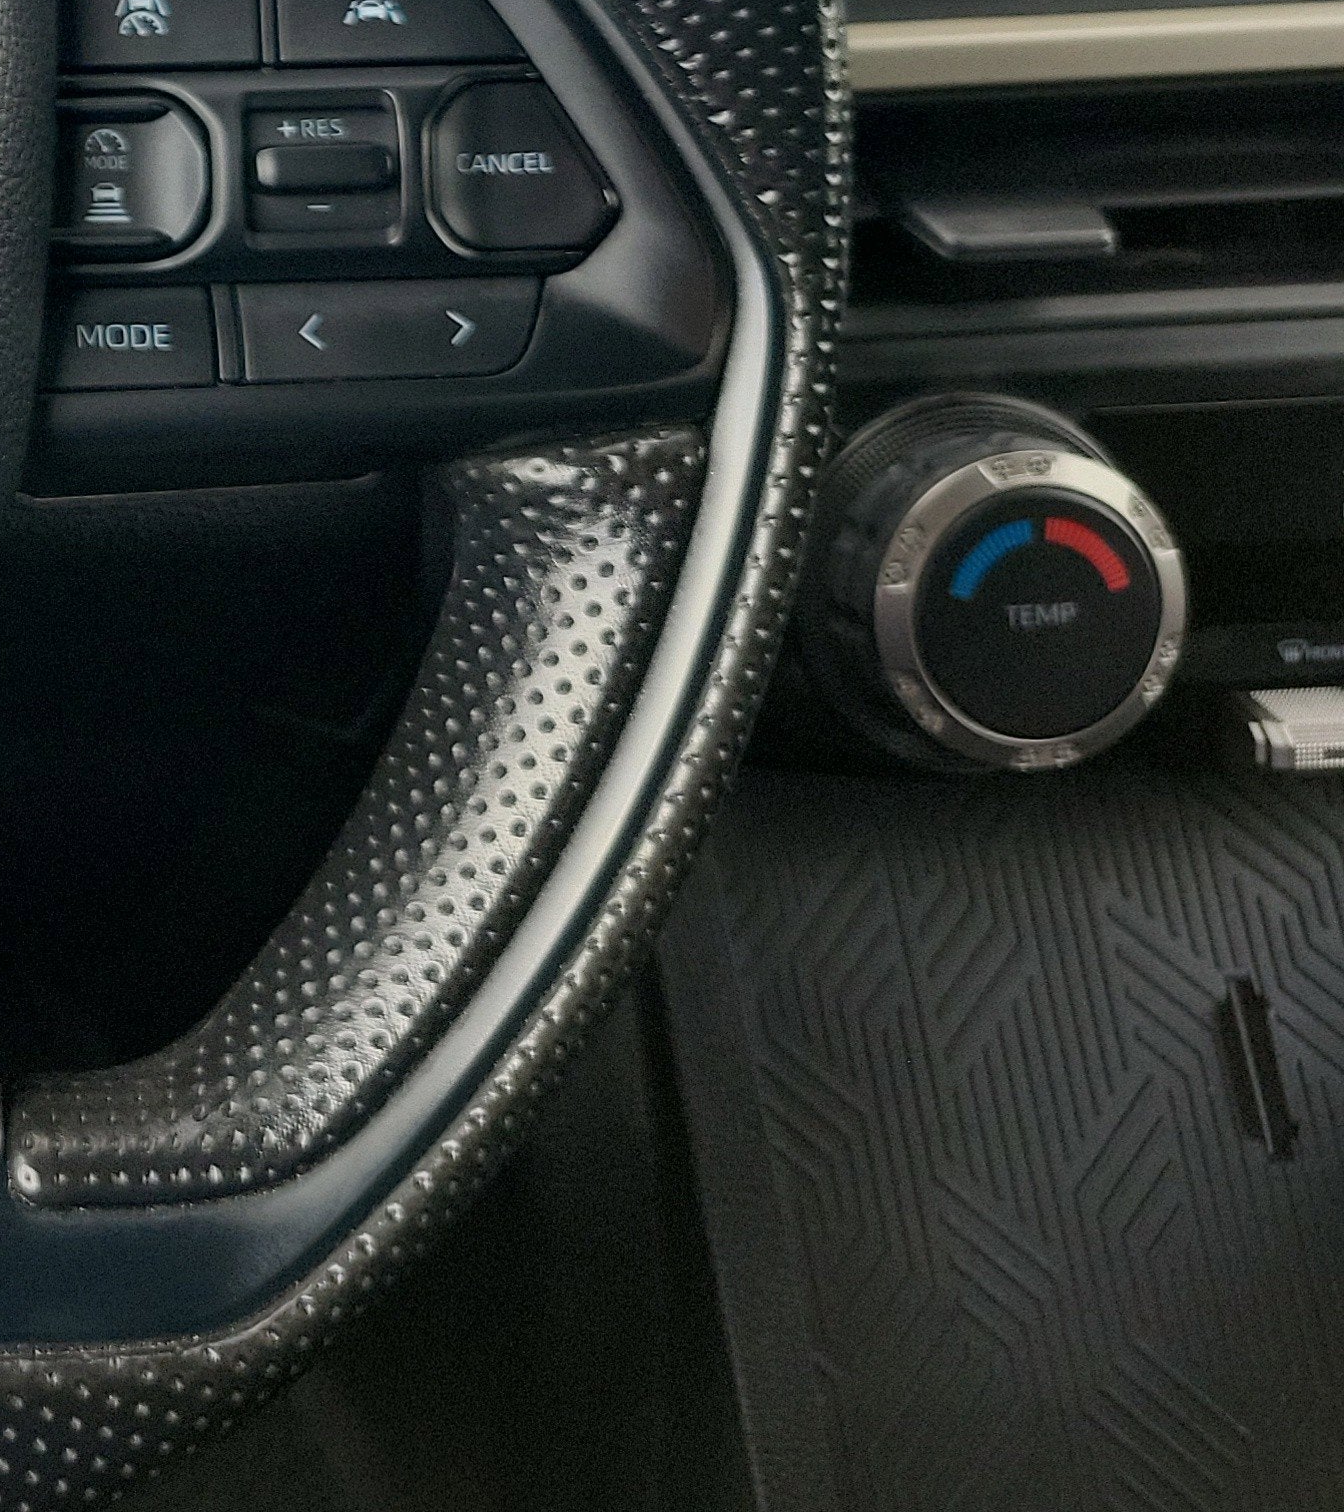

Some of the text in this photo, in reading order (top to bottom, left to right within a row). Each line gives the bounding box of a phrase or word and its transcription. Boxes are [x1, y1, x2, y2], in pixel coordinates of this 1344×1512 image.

[83, 155, 127, 170] MODE
[456, 151, 554, 175] CANCEL
[76, 324, 172, 350] MODE
[1006, 601, 1076, 628] TEMP
